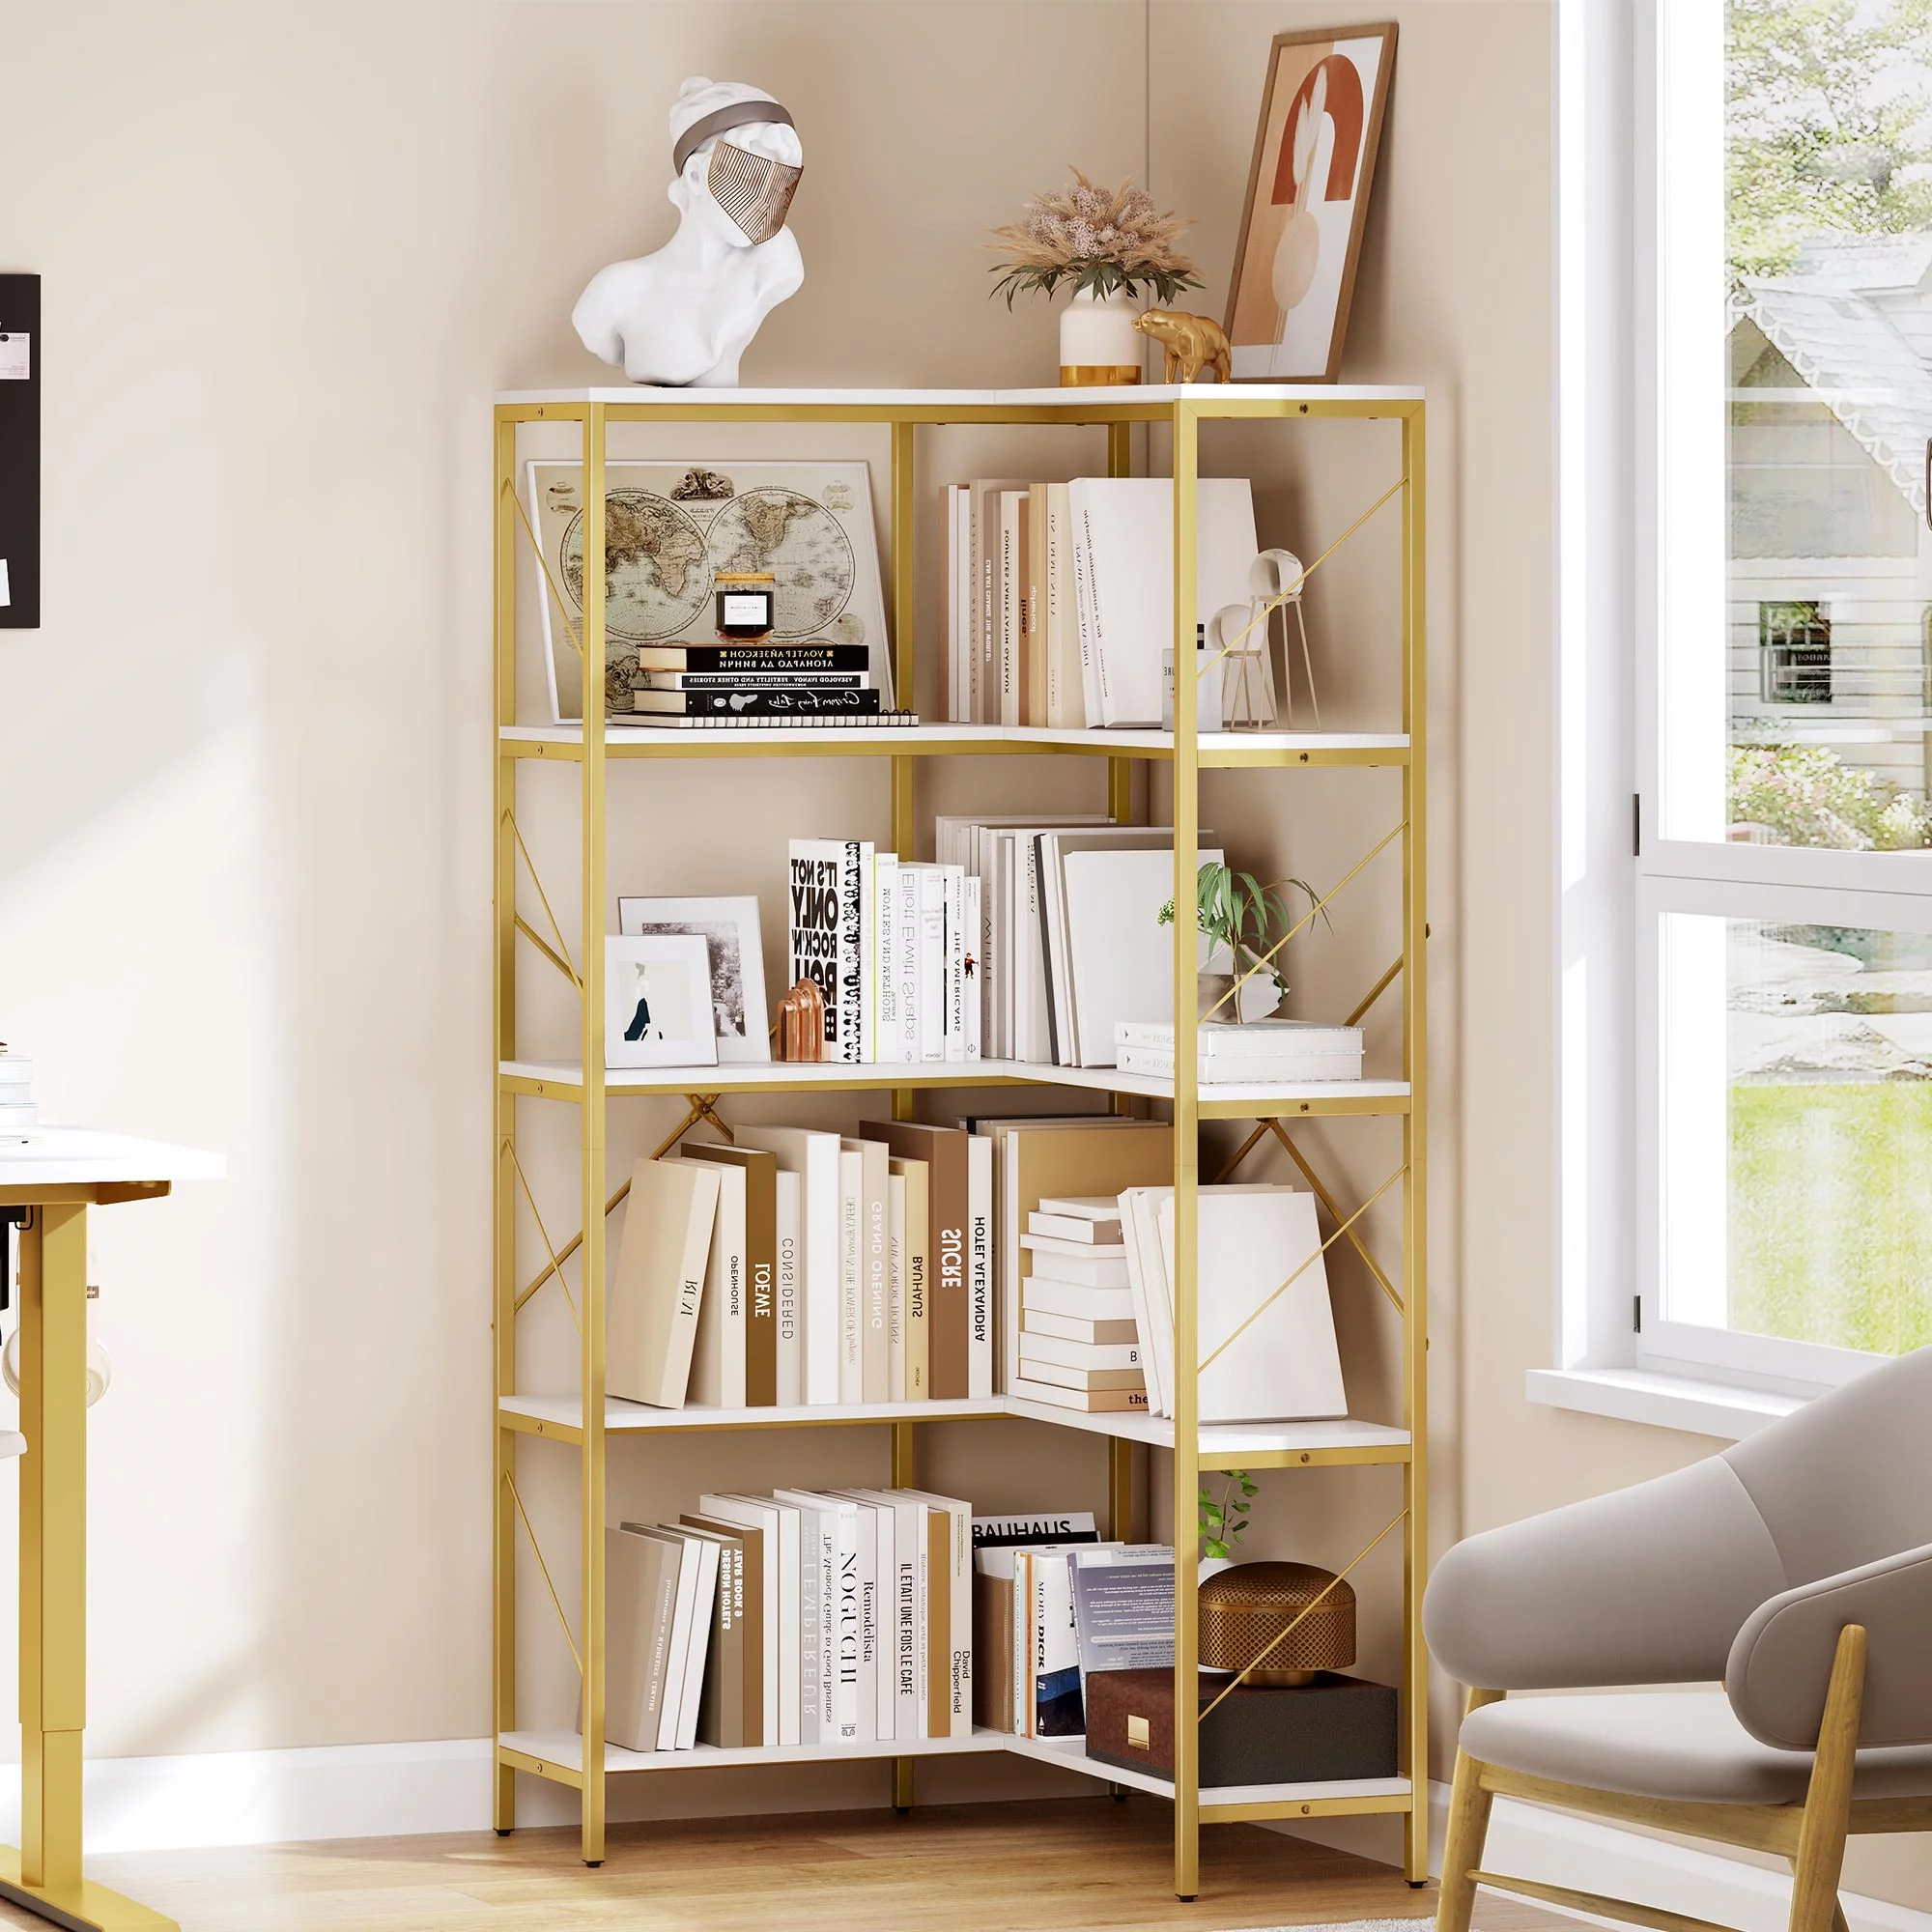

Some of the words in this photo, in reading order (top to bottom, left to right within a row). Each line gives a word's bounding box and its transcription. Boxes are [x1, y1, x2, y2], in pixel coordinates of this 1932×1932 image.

[1128, 1394, 1149, 1404] the
[972, 1520, 1071, 1537] BAUHAUS
[900, 1563, 913, 1573] IL
[900, 1576, 915, 1604] ÉTAIT
[840, 1552, 857, 1685] NOGUCHI
[864, 1581, 874, 1662] Remodelista
[900, 1606, 913, 1627] UNE
[900, 1630, 913, 1651] FOIS
[900, 1655, 913, 1666] LE
[900, 1669, 915, 1695] CAFÉ
[952, 1651, 961, 1714] Chipperfield
